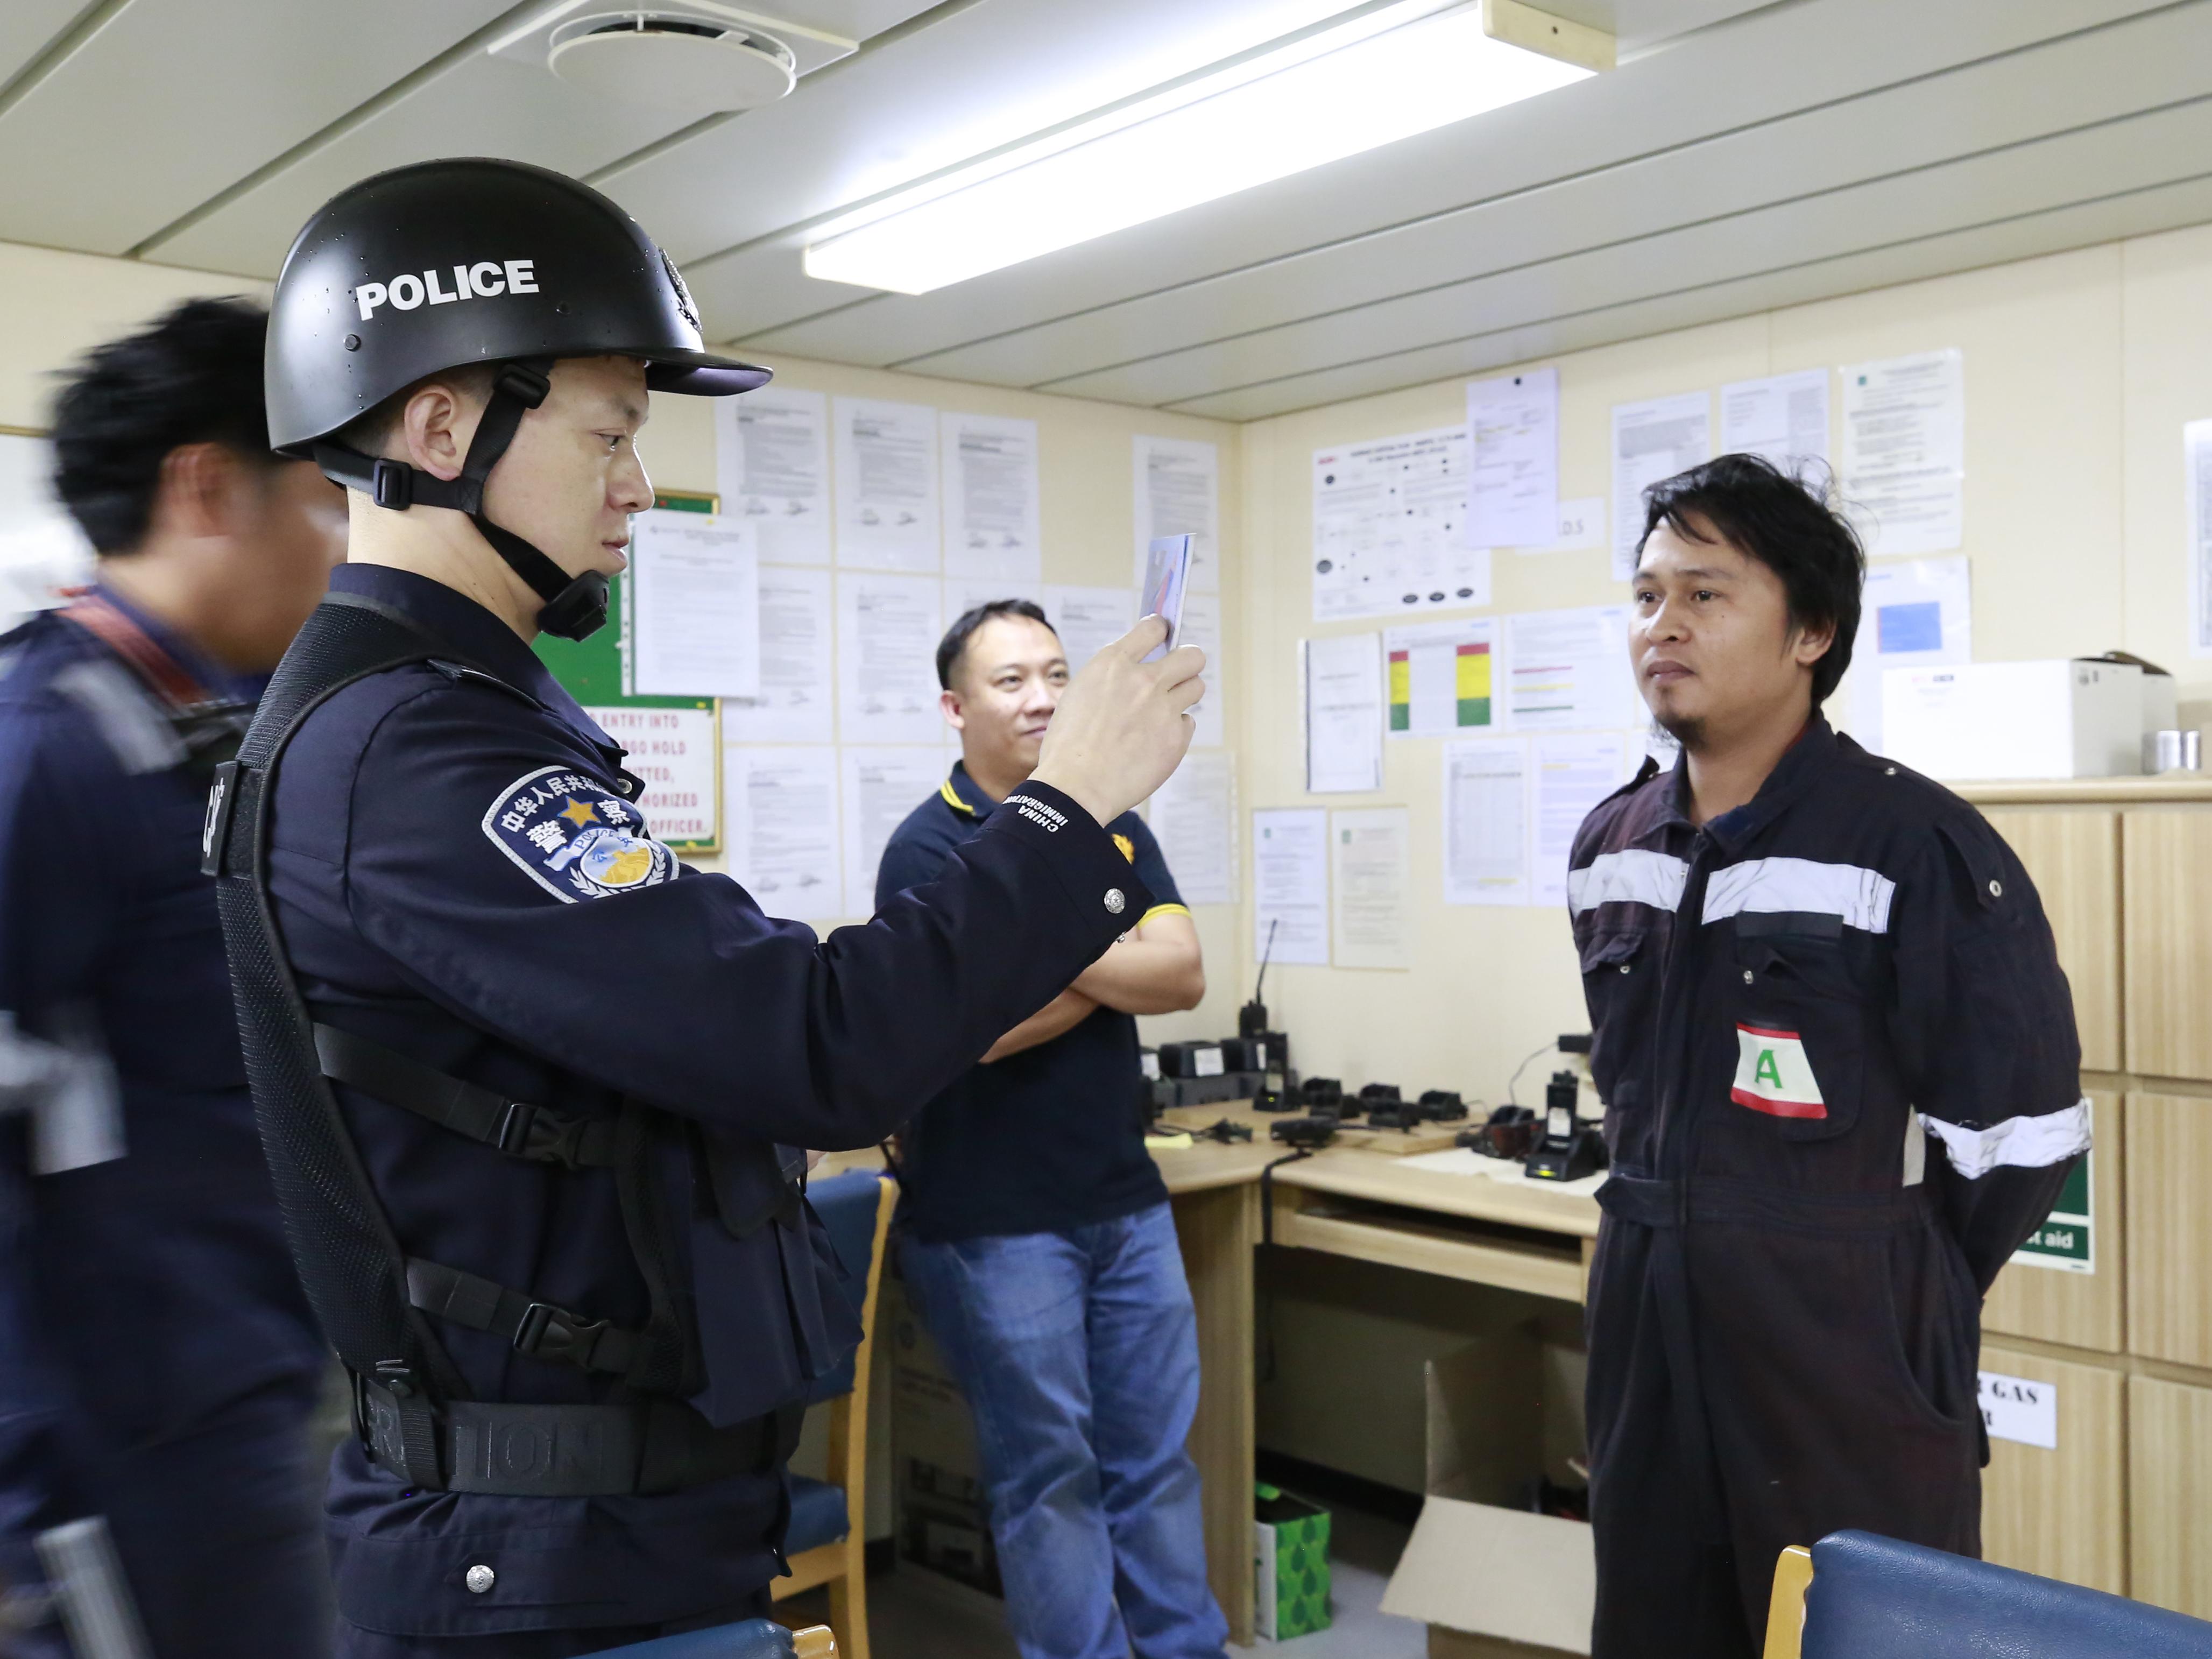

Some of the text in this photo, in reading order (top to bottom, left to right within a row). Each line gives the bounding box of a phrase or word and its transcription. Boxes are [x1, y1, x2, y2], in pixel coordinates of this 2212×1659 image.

[356, 260, 539, 321] POLICE
[602, 714, 644, 727] ENTRY
[649, 714, 679, 728] INTO
[621, 740, 685, 754] RGO HOLD
[501, 775, 610, 832] 中华人民共和
[635, 793, 698, 807] HORIZED
[1017, 805, 1059, 832] CHINA
[1755, 1049, 1783, 1089] A
[2045, 1230, 2074, 1249] aid
[1992, 1381, 2038, 1404] GAS
